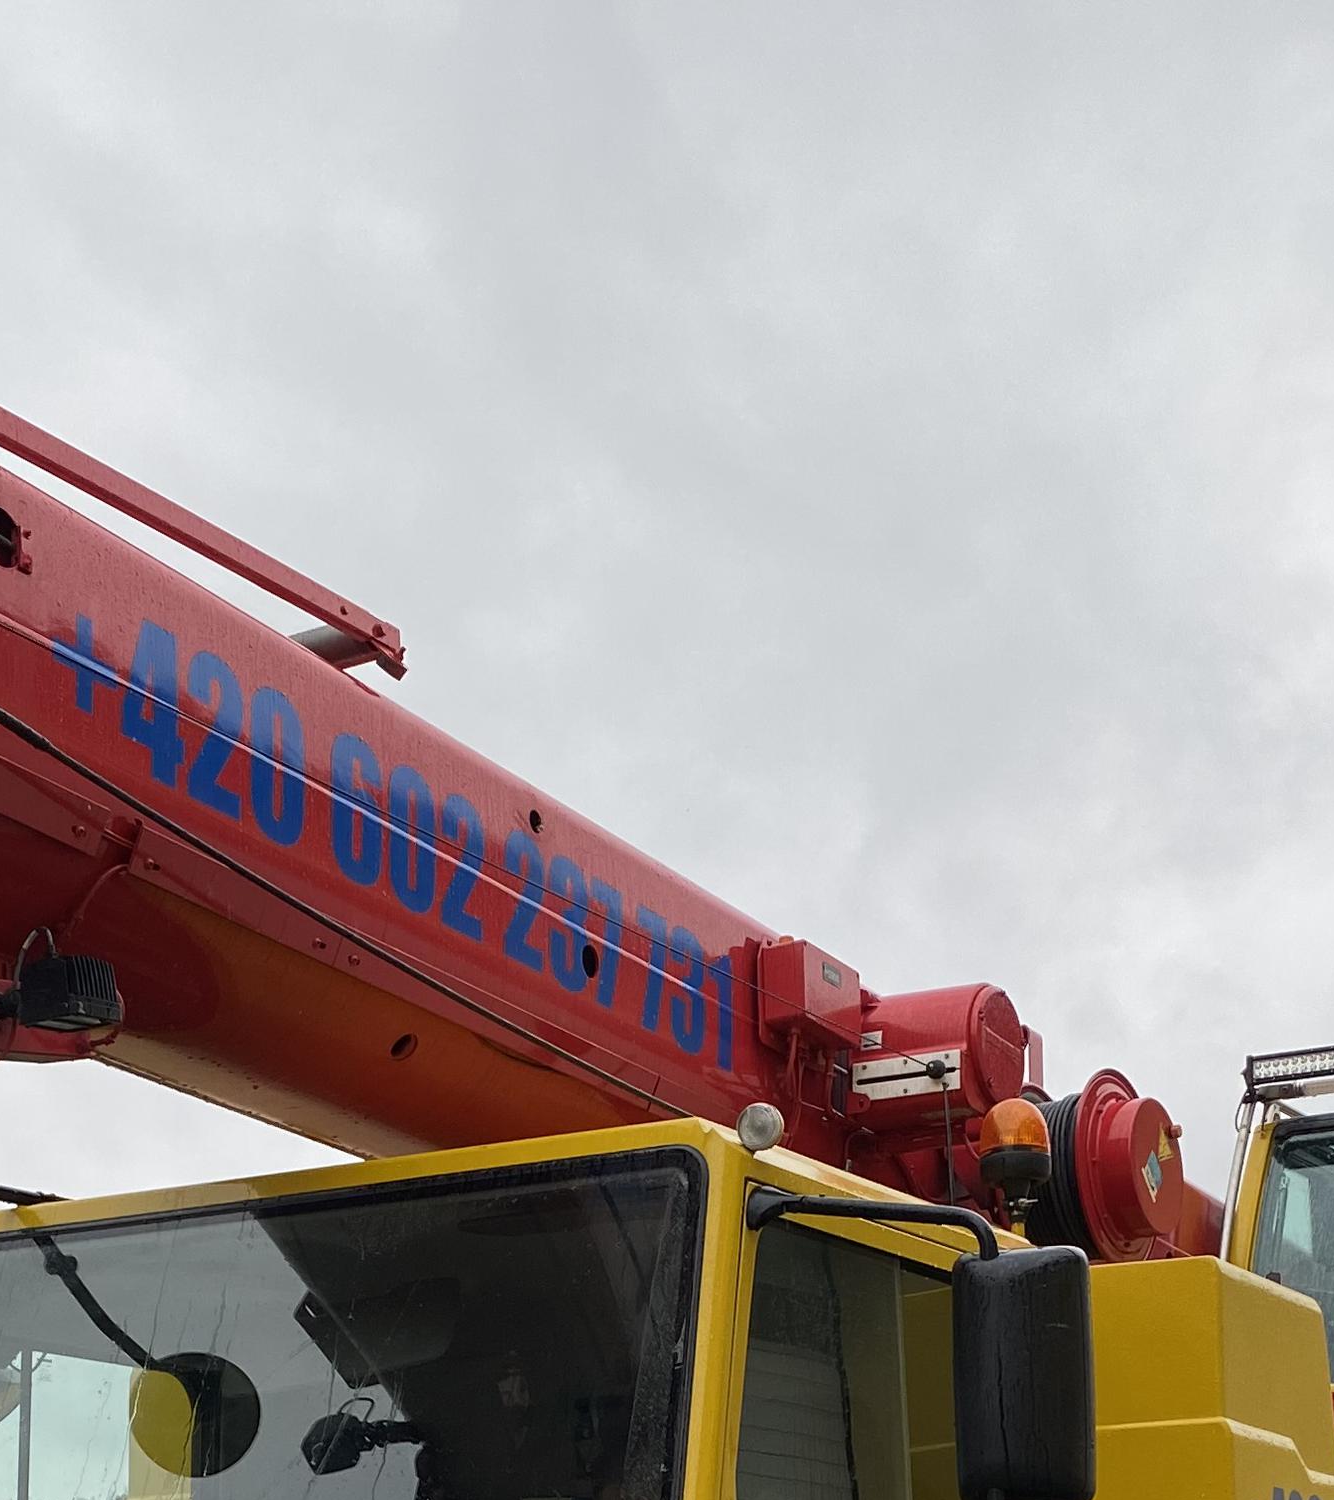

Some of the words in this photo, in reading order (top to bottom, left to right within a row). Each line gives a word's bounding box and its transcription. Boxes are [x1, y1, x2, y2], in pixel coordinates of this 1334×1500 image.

[52, 614, 305, 846] +420
[329, 733, 482, 941] 602
[504, 829, 623, 1007] 237
[637, 907, 733, 1069] 731
